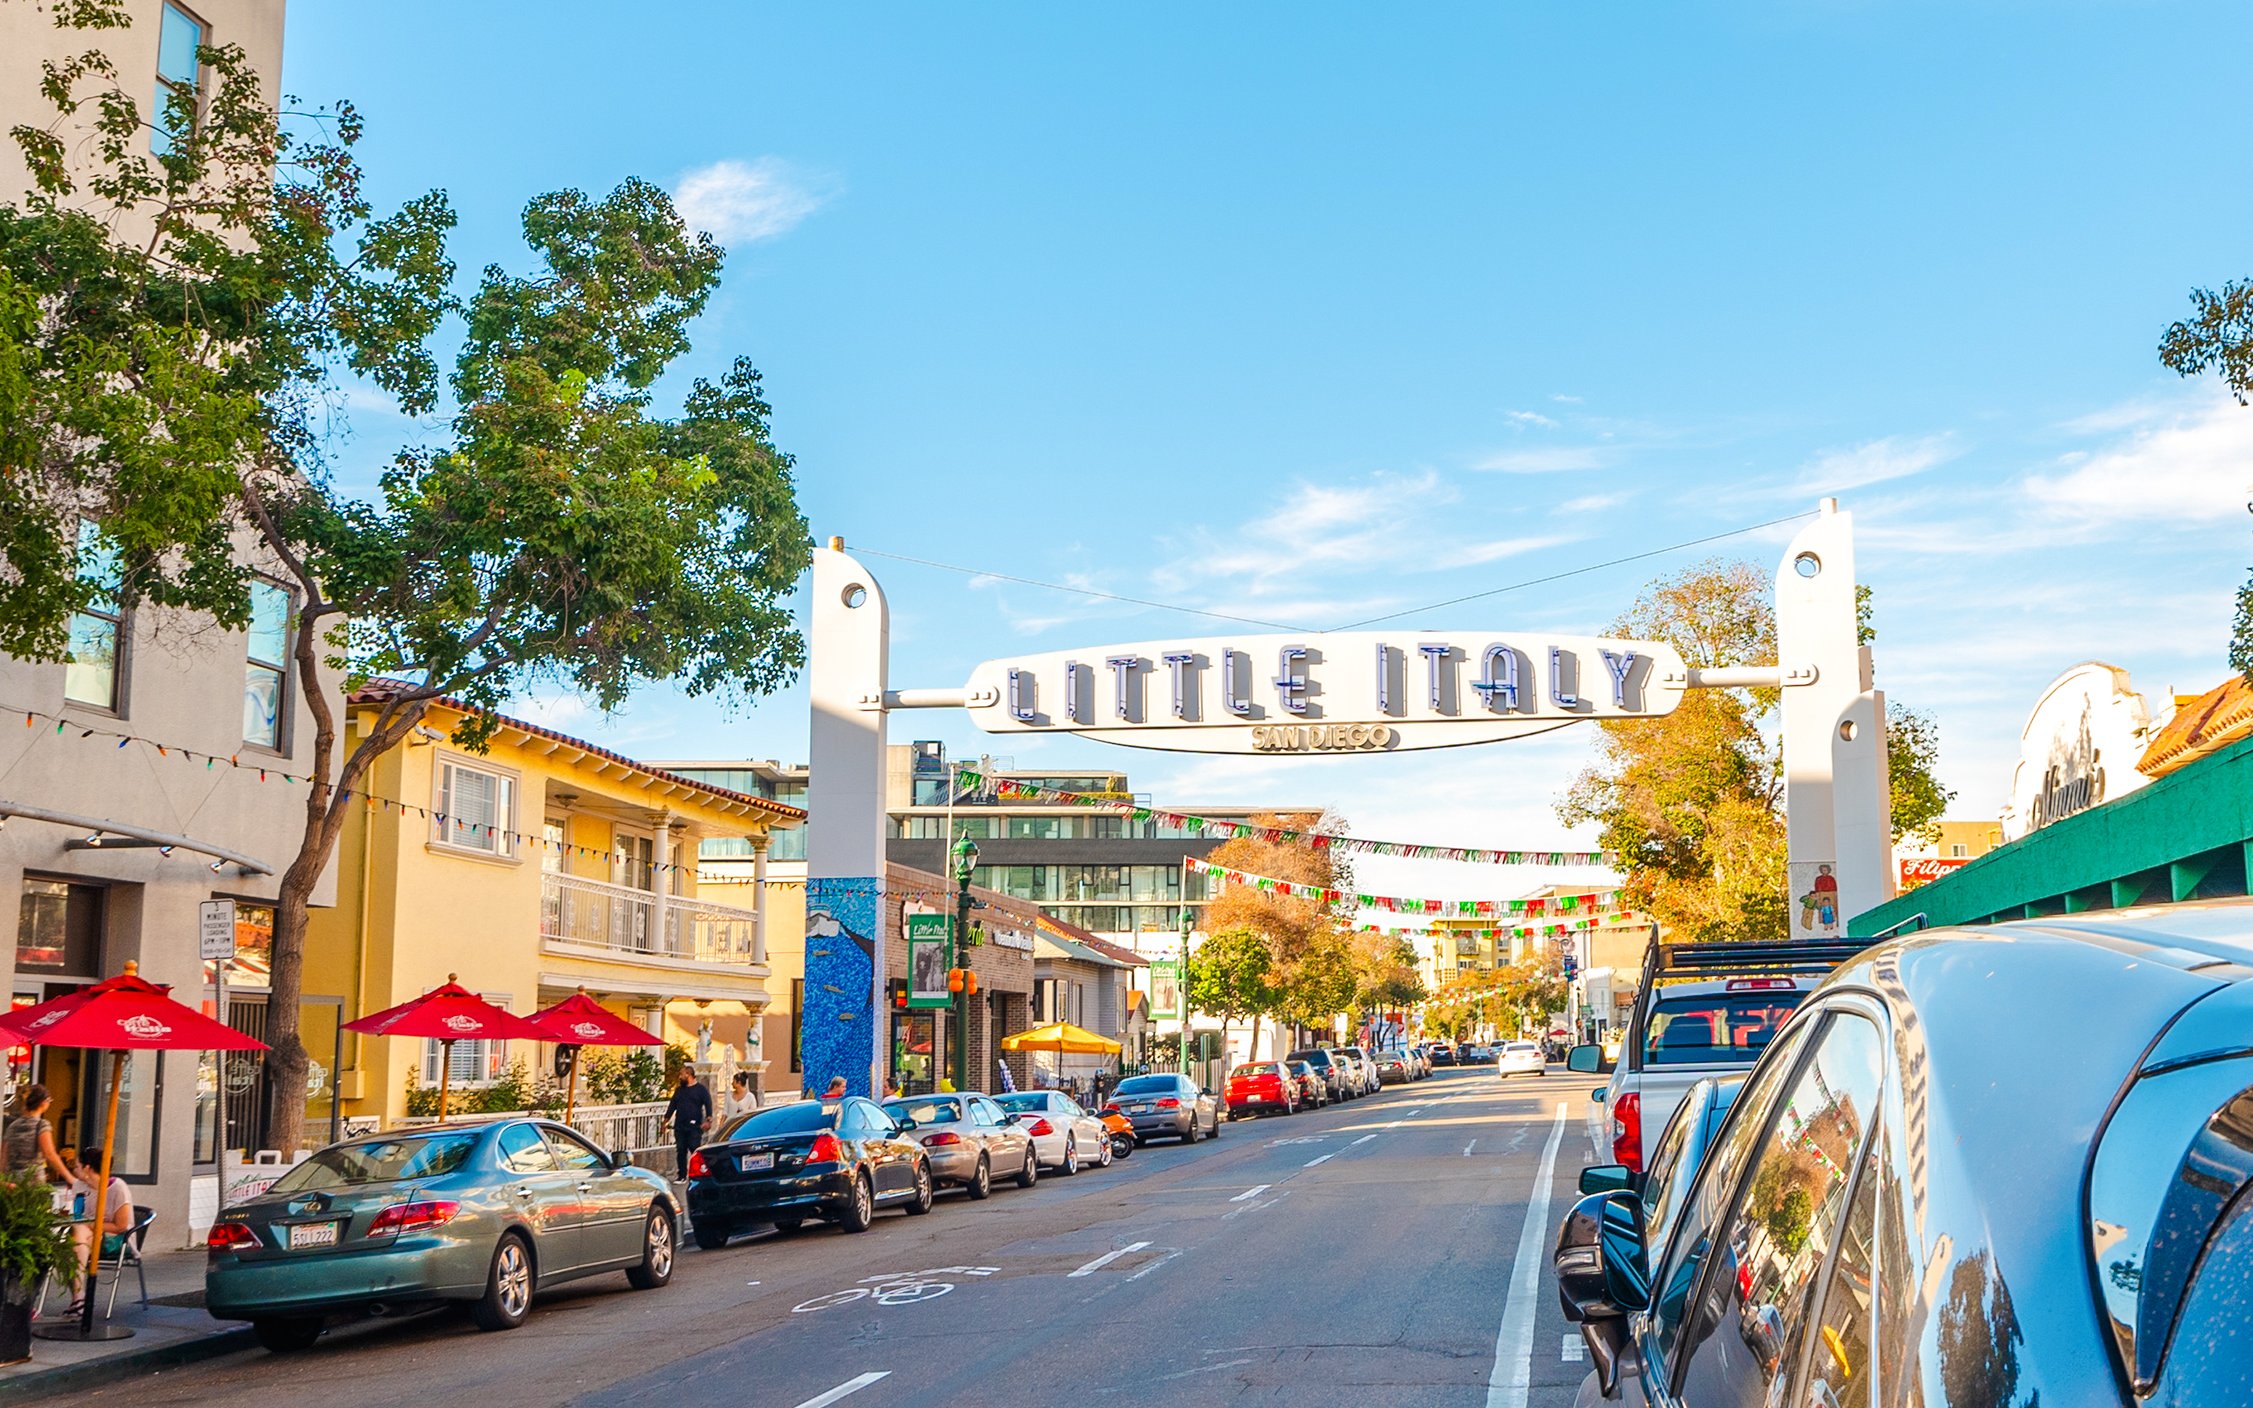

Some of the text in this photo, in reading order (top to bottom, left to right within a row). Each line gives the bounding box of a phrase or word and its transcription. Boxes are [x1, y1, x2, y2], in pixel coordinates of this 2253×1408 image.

[1007, 641, 1637, 721] LITTLE ITALY
[1252, 723, 1392, 750] SAN DIEGO
[967, 919, 985, 947] erde
